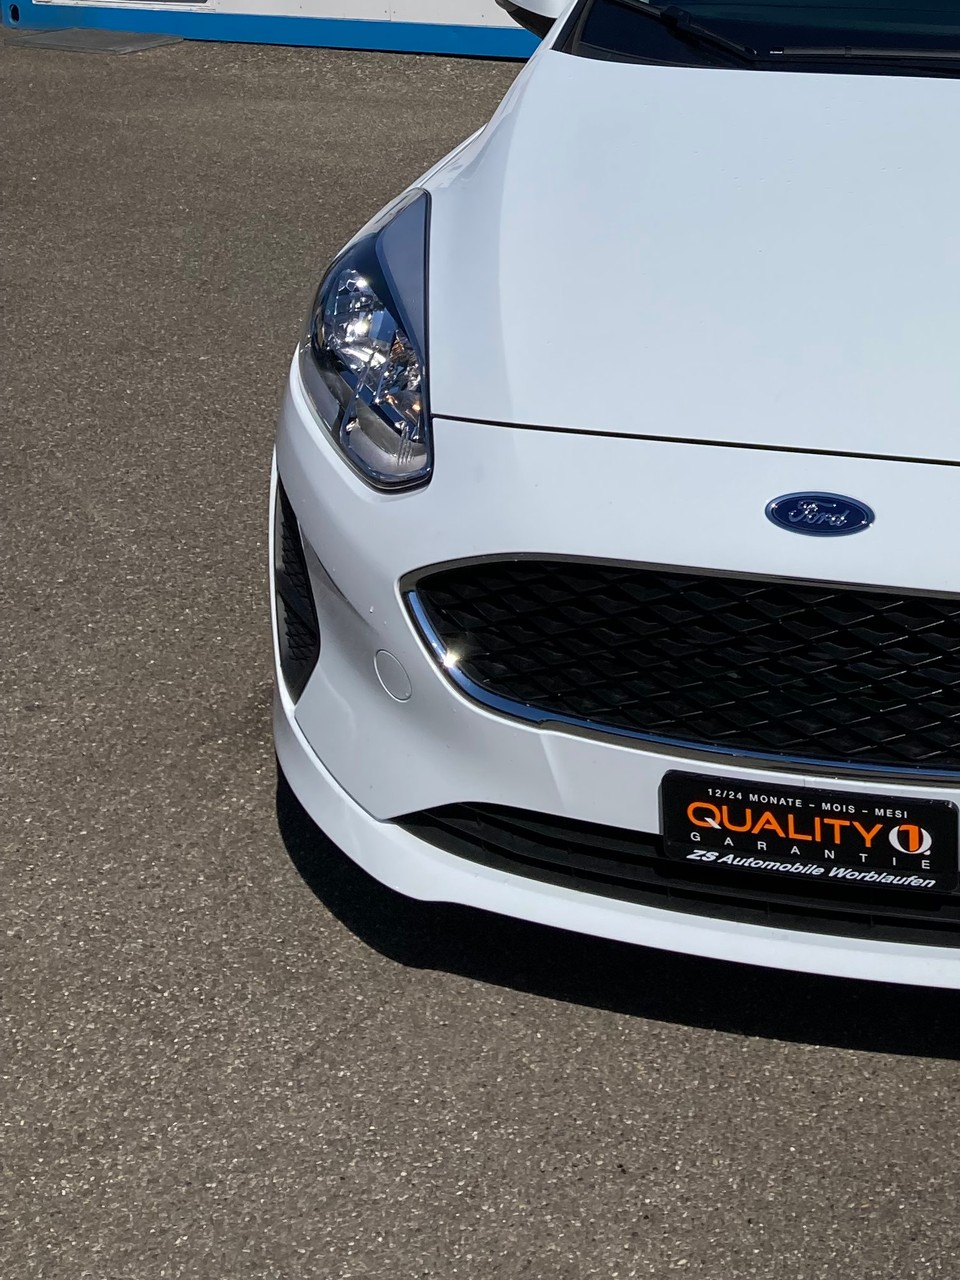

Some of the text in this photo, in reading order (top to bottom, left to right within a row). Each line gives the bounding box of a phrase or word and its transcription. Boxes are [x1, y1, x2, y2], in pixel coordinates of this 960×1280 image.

[788, 500, 851, 526] Ford
[707, 788, 743, 801] 12/24
[749, 793, 802, 808] MONATE
[821, 802, 855, 814] MOIS
[874, 808, 908, 819] MESI
[686, 801, 883, 848] QUALITY
[686, 849, 936, 889] ZS Automobile Worblaufen
[690, 831, 930, 870] GARANTIE
